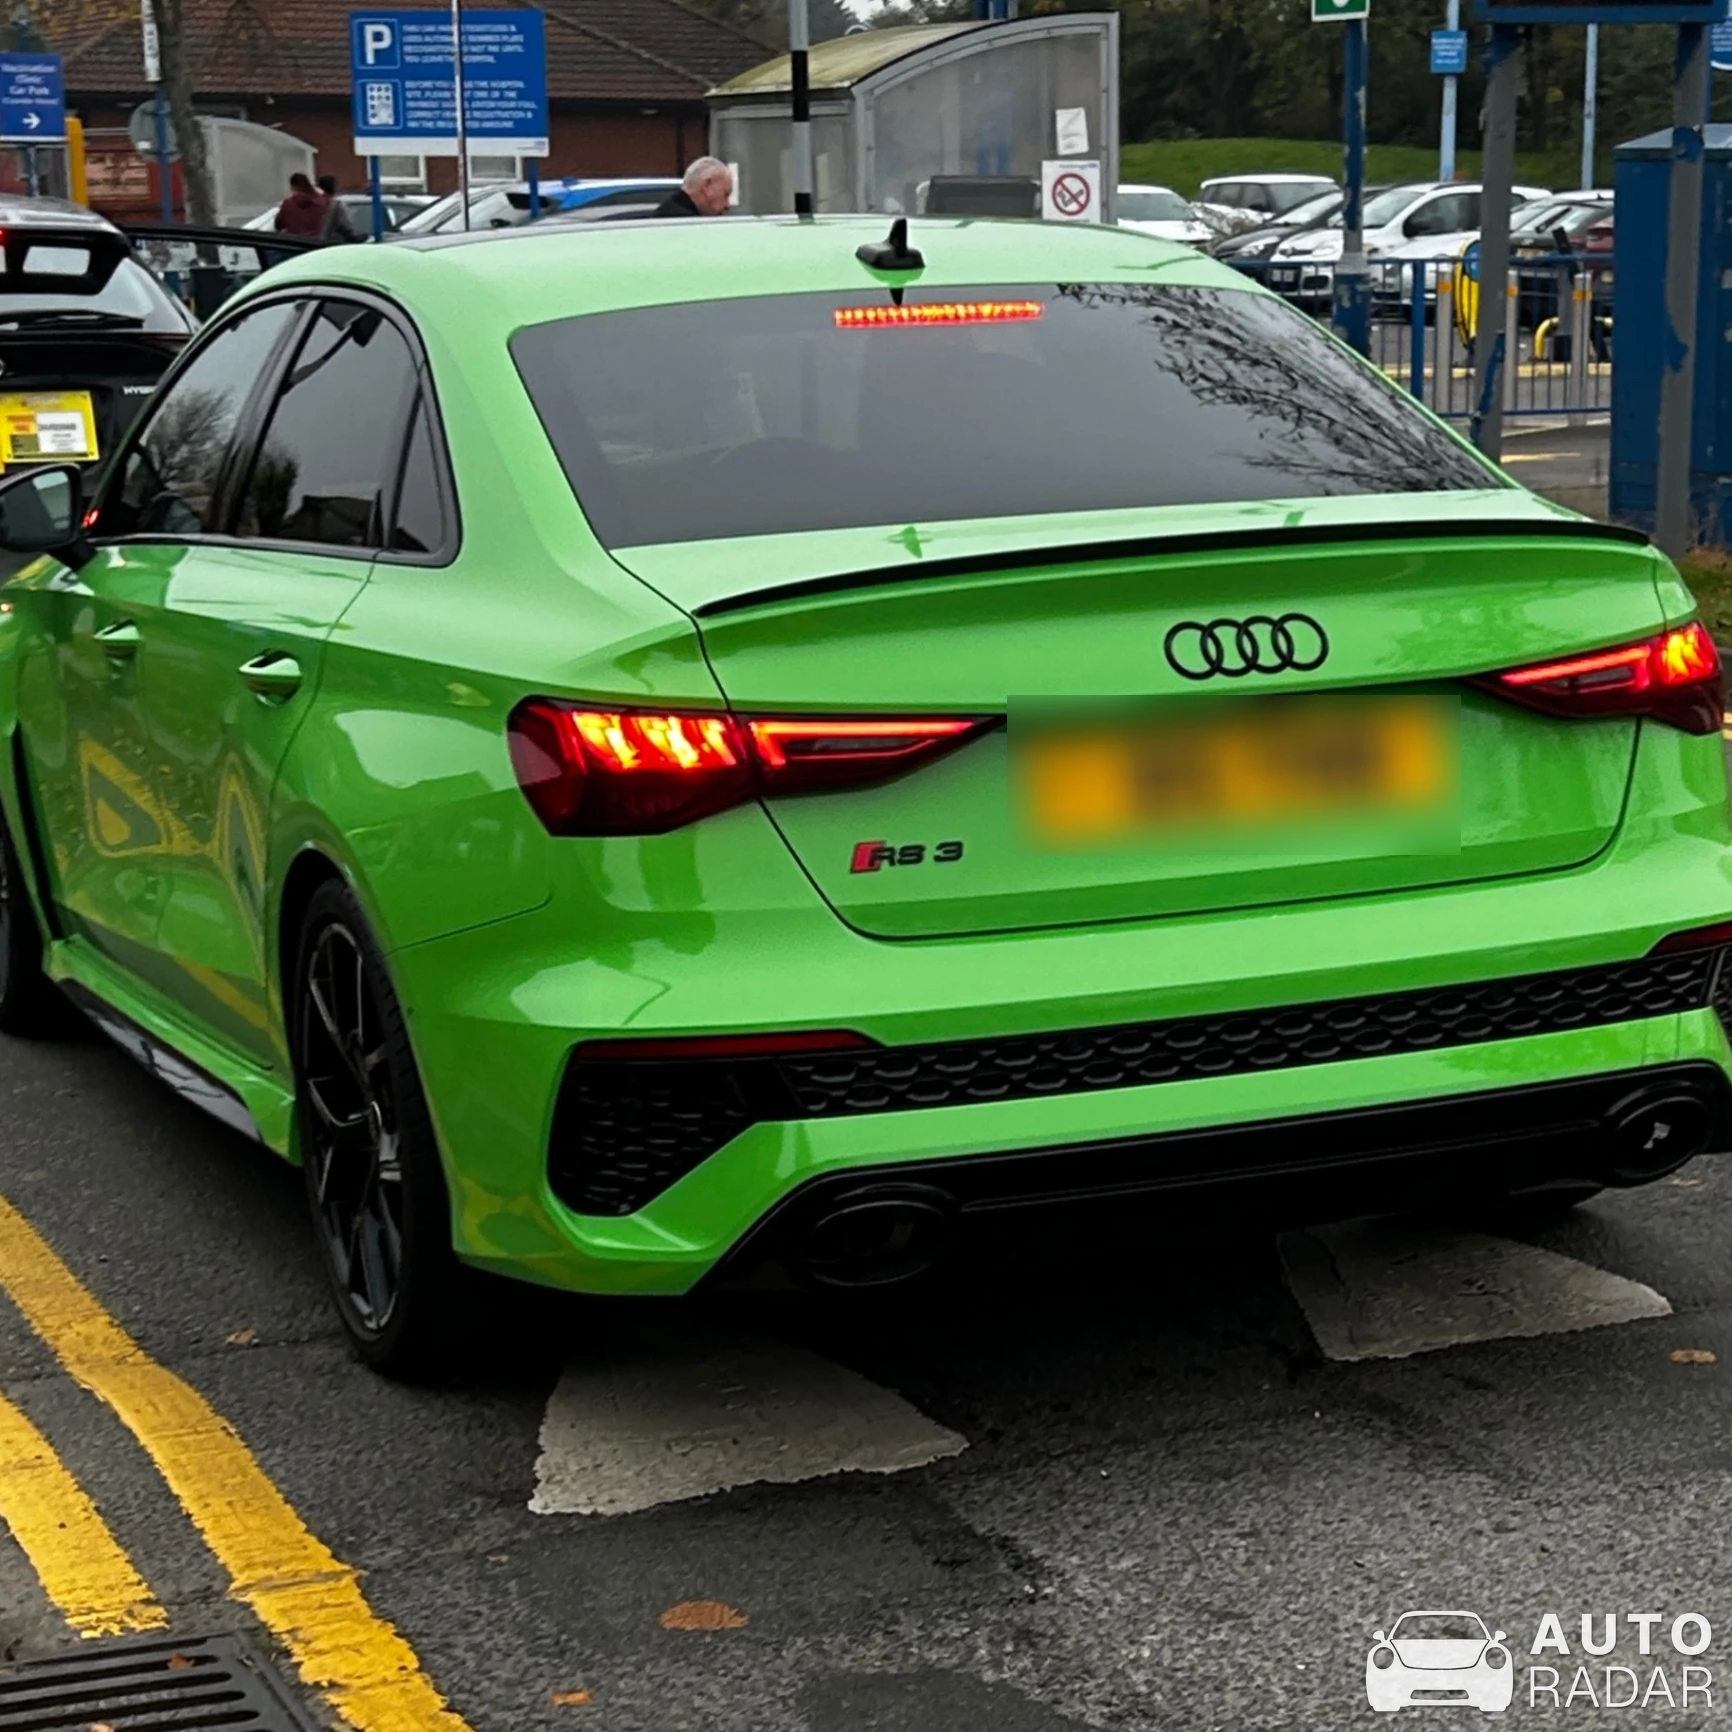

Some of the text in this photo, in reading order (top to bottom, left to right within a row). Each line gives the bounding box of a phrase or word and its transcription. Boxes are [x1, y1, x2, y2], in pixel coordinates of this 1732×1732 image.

[364, 24, 392, 65] P
[864, 841, 963, 868] RS 3
